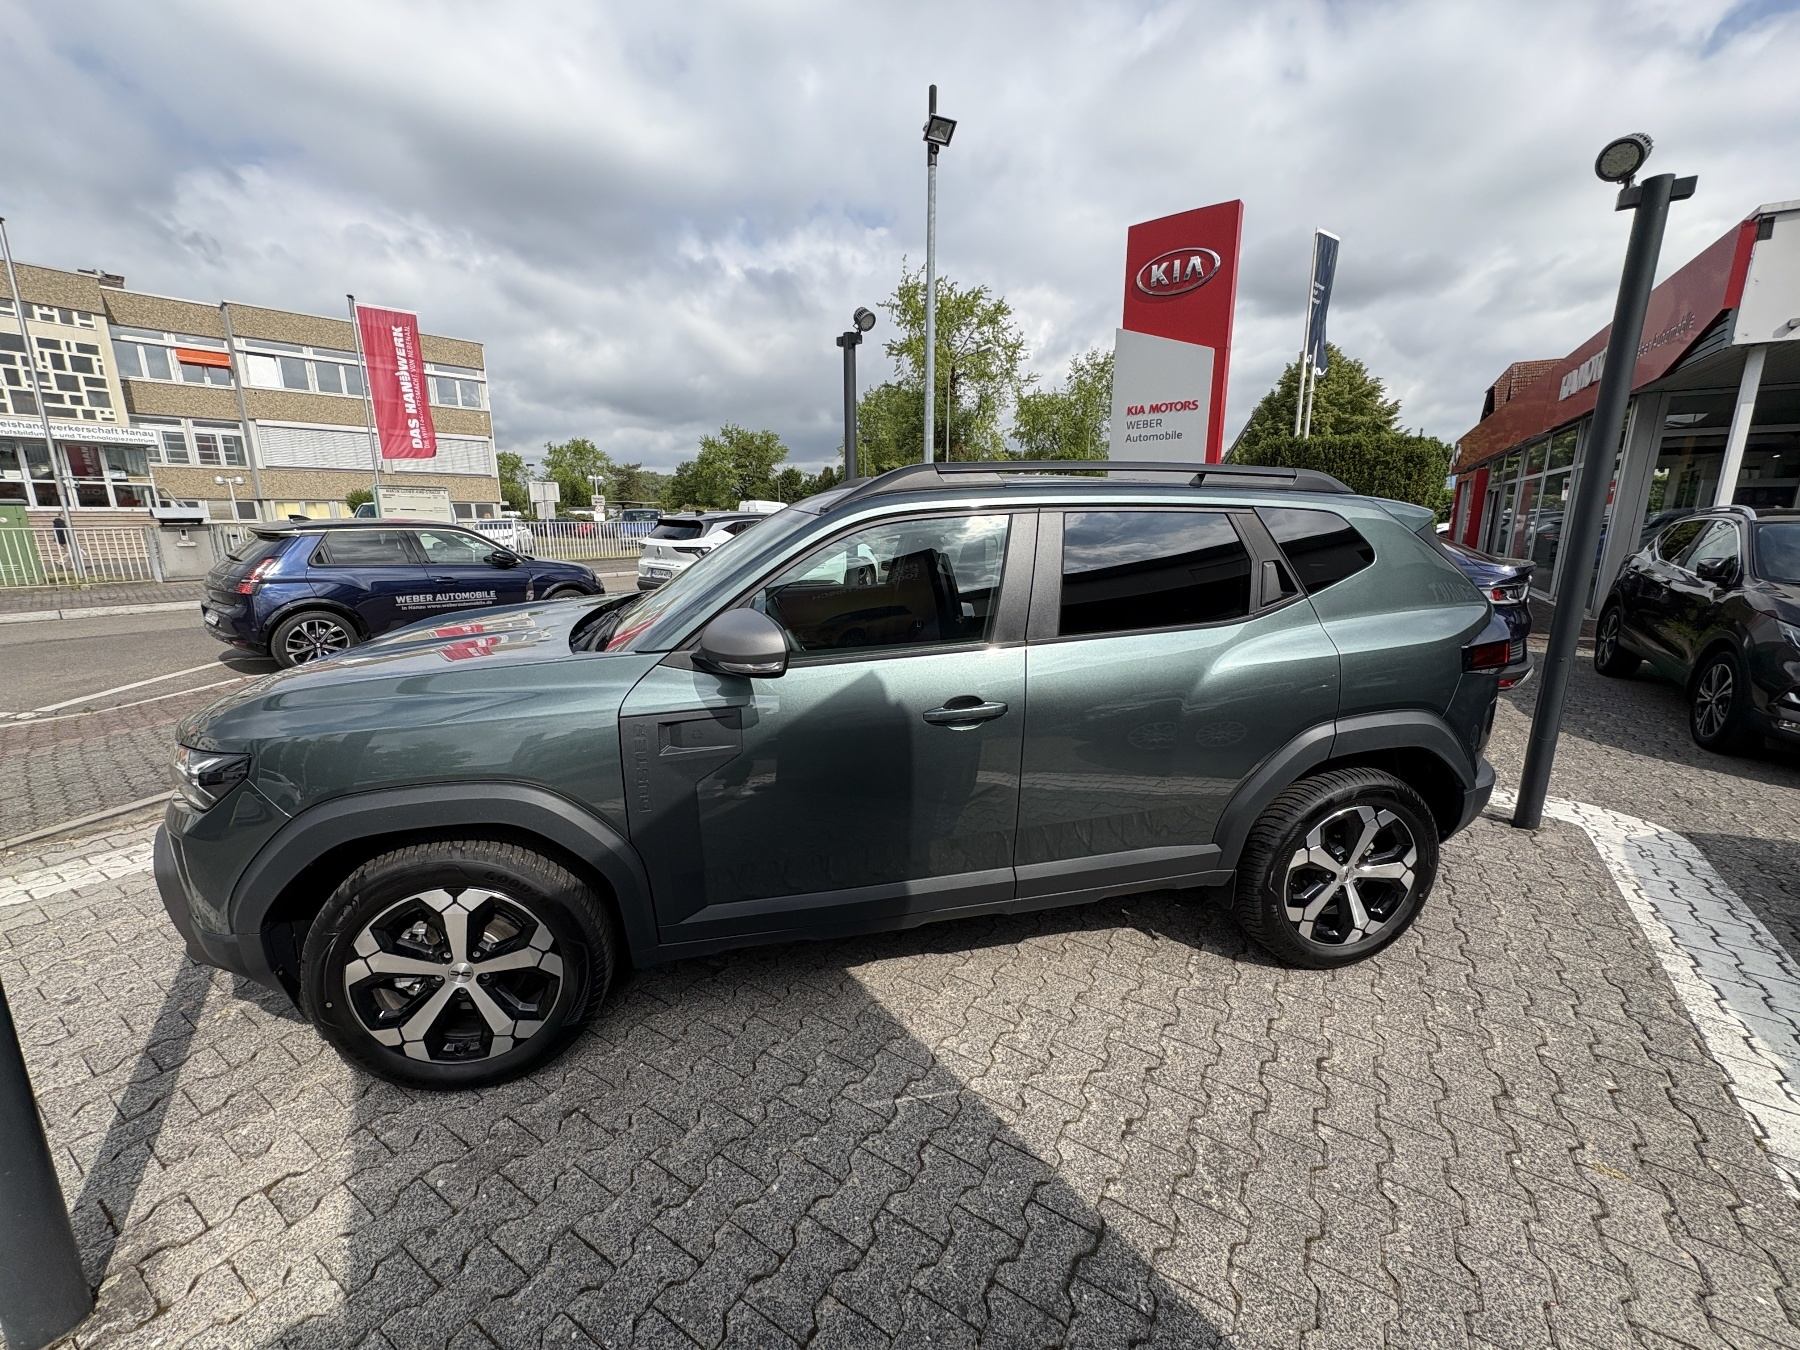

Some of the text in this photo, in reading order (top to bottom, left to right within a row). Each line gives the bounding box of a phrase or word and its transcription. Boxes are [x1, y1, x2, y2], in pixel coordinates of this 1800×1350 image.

[1150, 255, 1204, 288] KIA
[391, 326, 424, 449] DAS HANDWERK
[1126, 400, 1199, 416] KIA MOTORS
[1126, 418, 1163, 430] WEBER
[77, 433, 155, 443] Technologiezentrum
[121, 428, 154, 437] Hanau
[1125, 430, 1183, 443] Automobile
[395, 590, 497, 604] WEBER AUTOMOBILE
